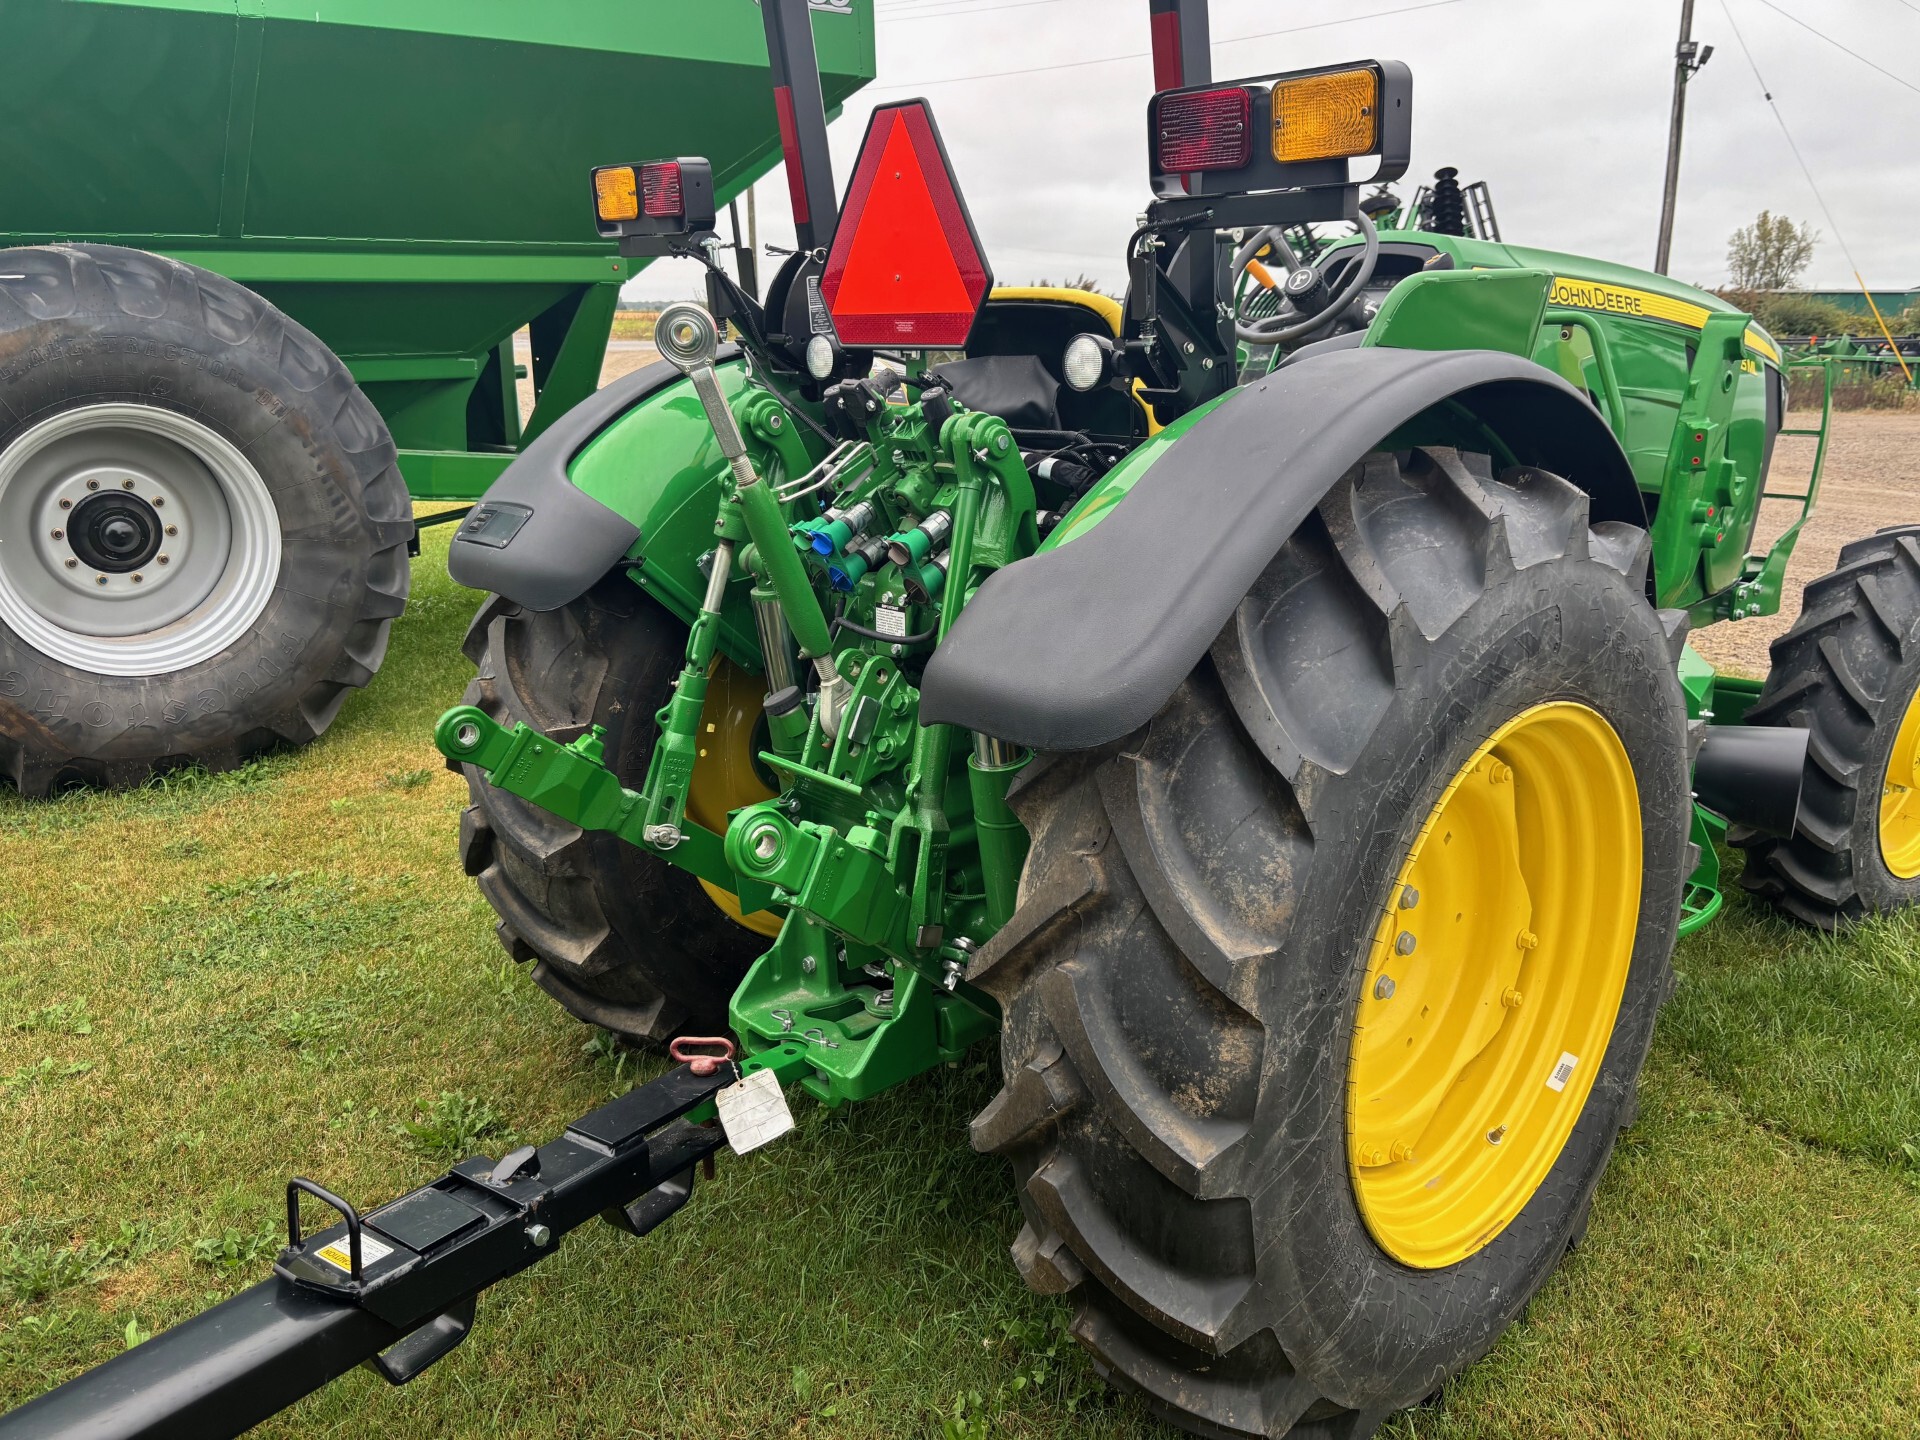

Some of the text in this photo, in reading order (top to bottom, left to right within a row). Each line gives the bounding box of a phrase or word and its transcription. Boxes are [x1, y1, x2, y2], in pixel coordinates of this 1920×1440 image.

[1550, 282, 1643, 313] JOHN DEERE
[102, 335, 250, 388] TRACTION
[0, 631, 306, 729] Firestone
